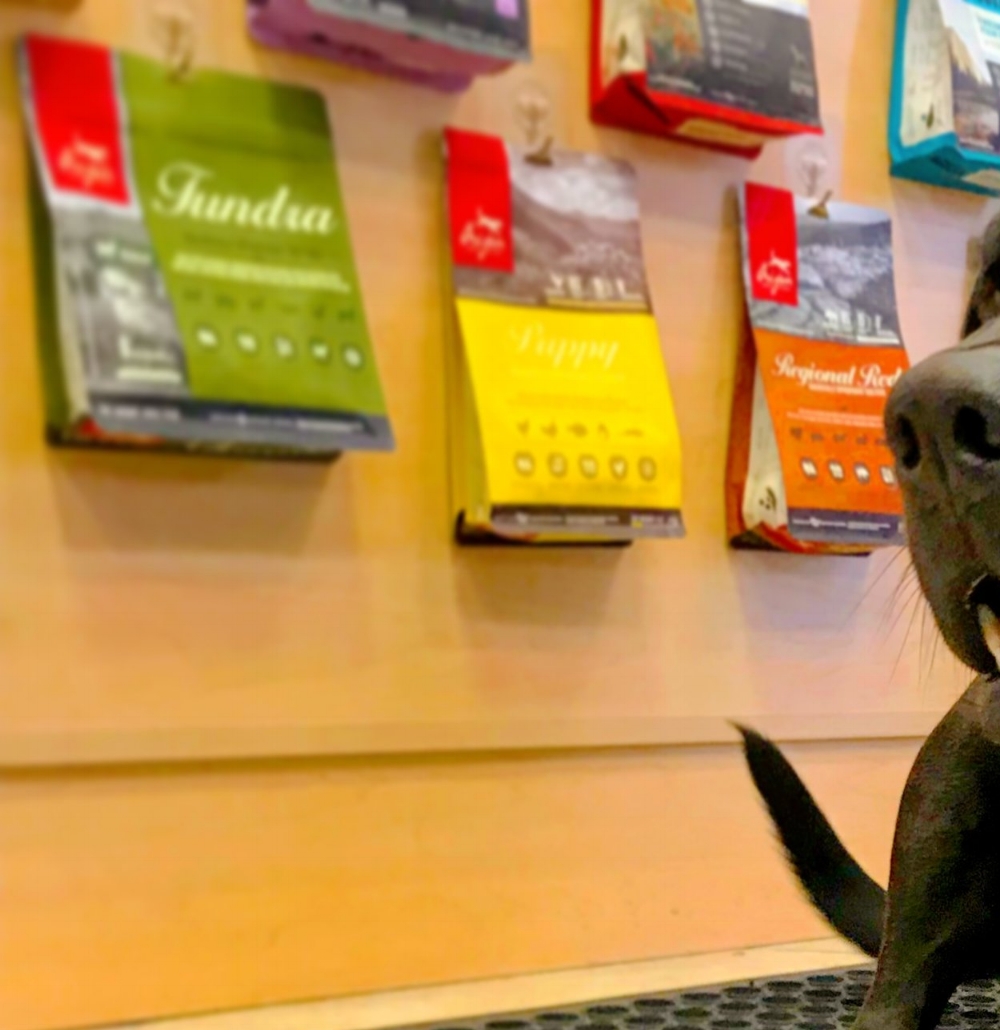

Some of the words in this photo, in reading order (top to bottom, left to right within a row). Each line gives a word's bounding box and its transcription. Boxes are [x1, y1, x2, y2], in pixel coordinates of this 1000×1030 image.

[152, 161, 338, 235] Tundra
[509, 321, 620, 370] Puppy
[771, 352, 856, 387] Regional
